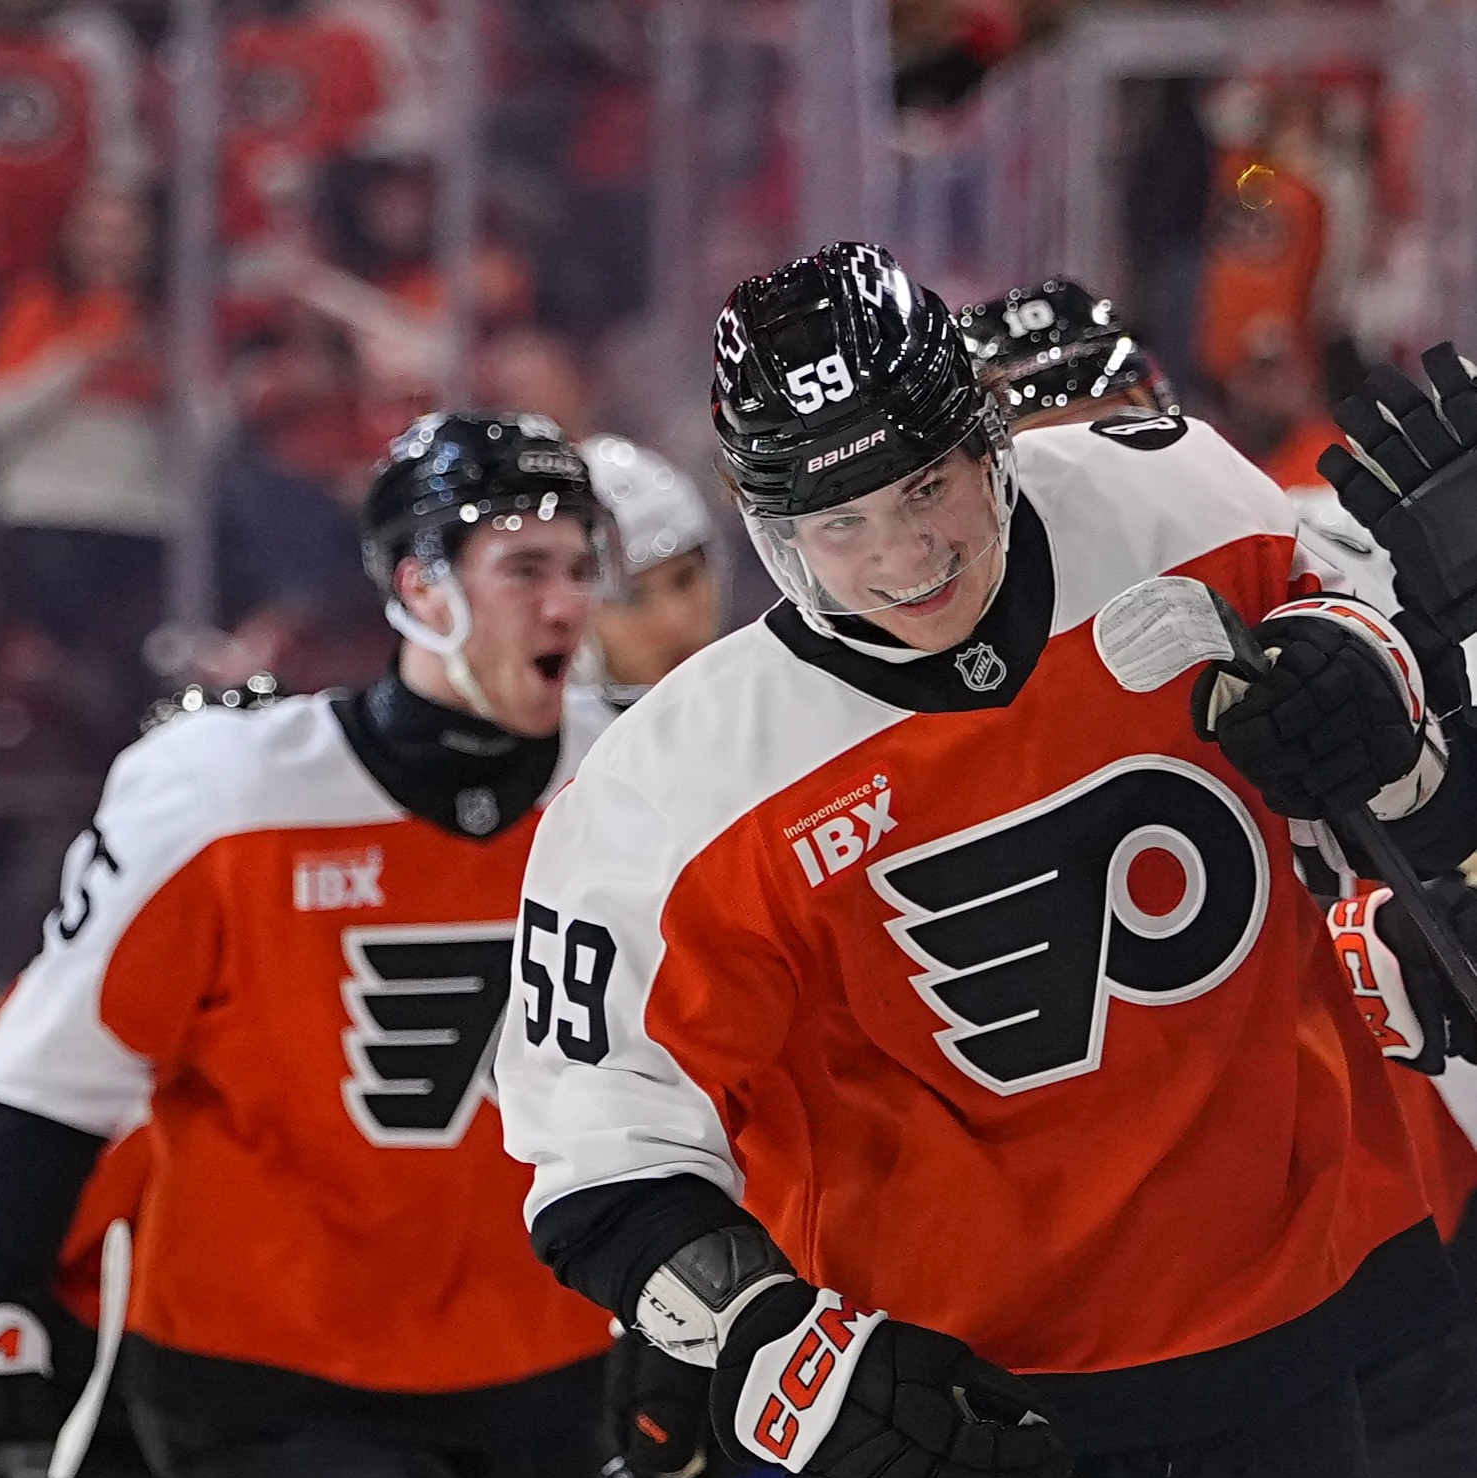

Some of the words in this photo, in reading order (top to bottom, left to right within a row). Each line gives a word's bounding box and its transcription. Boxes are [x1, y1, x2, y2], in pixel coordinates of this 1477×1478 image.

[1002, 299, 1055, 339] 10
[786, 353, 855, 415] 59
[807, 429, 886, 473] BAUER
[973, 655, 991, 684] NHL
[783, 783, 873, 840] Independence
[791, 788, 900, 889] IBX
[521, 897, 618, 1067] 59
[753, 1296, 878, 1460] CCM
